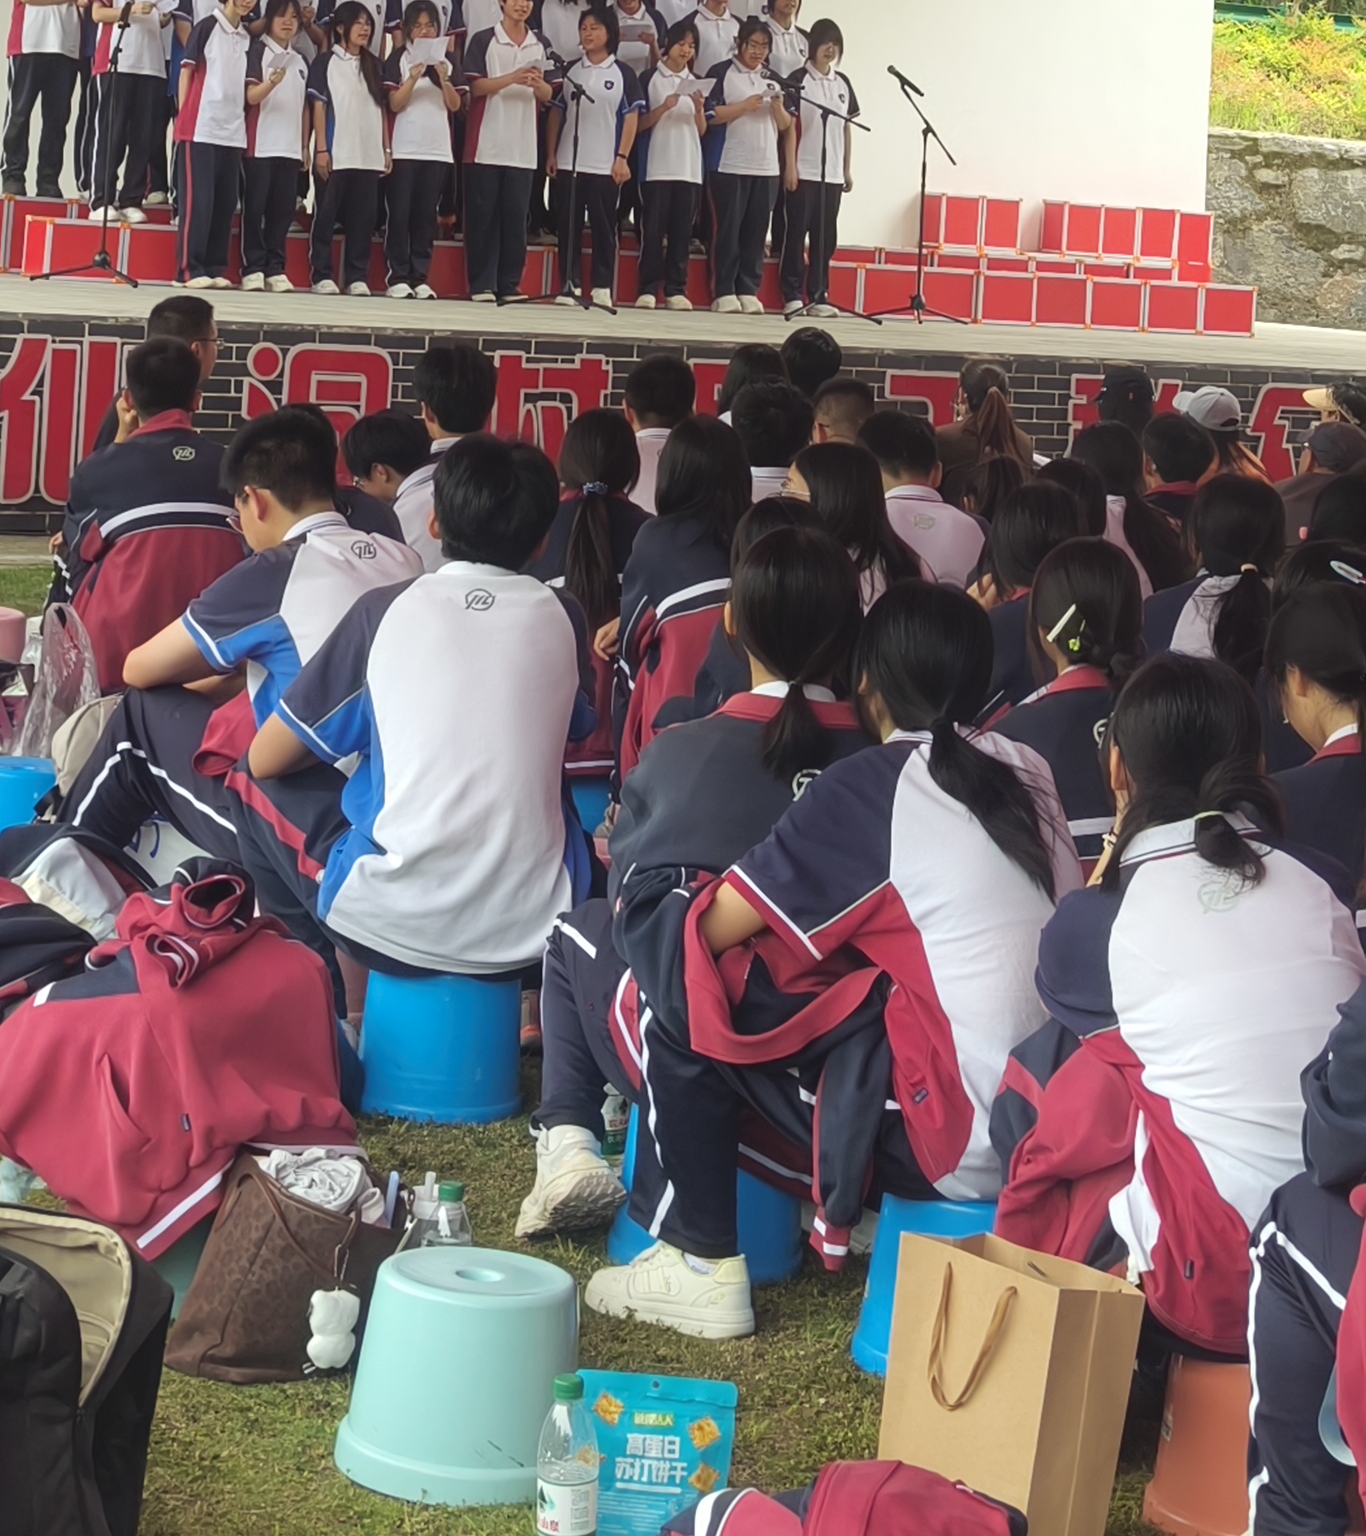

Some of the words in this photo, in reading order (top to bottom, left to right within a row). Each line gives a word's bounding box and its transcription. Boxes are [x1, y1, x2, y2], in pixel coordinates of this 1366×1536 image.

[626, 1433, 680, 1459] 高蛋白
[615, 1457, 688, 1484] 苏打饼干
